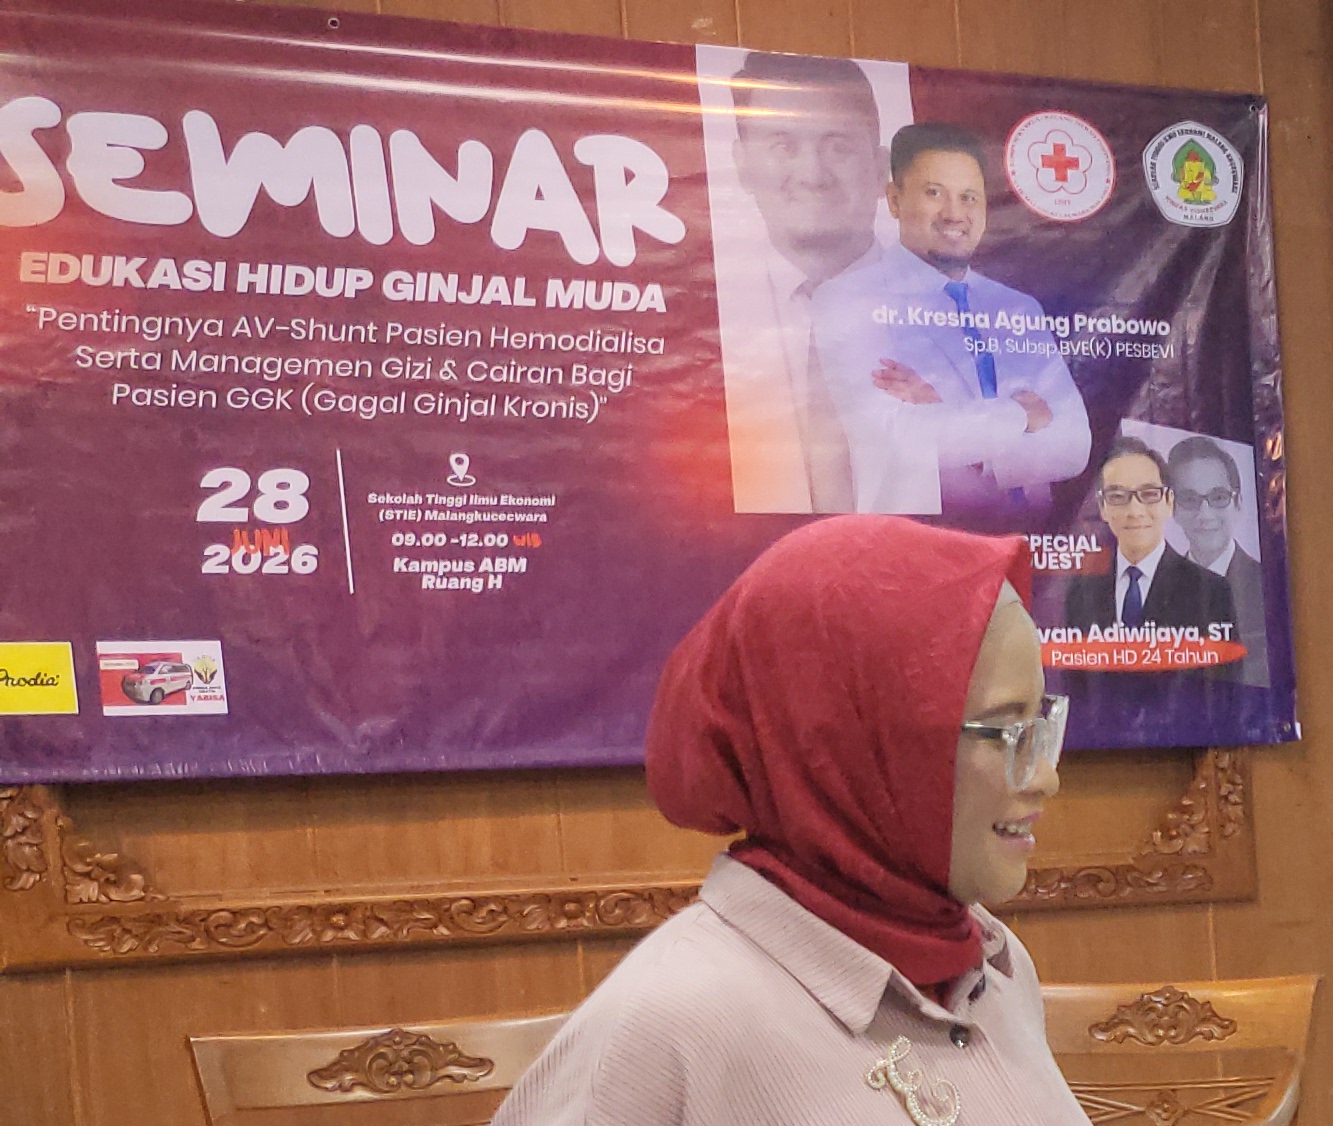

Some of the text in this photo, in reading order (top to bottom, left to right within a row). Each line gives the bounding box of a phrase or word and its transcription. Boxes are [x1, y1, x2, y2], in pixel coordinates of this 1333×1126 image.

[0, 96, 686, 266] SEMINAR
[20, 251, 667, 313] EDUKASI HIDUP GINJAL MUDA
[232, 316, 377, 344] AV-Shunt
[385, 322, 482, 348] Pasien
[490, 327, 665, 355] Hemodialisa
[872, 305, 1170, 338] dr. Kresna Agung Prabowo
[1116, 342, 1174, 359] PESBEVI
[76, 345, 633, 393] Serta Managemen Gizi & Cairan Bagi
[112, 383, 217, 408] Pasien
[226, 387, 293, 411] GGK
[302, 382, 405, 420] (Gagal
[414, 391, 496, 422] Ginjal
[196, 467, 310, 524] 28
[368, 492, 556, 507] Sekolah Tinggi Ilmu Ekonomi
[379, 509, 422, 522] (STIE)
[231, 527, 290, 556] JUNI
[392, 533, 446, 547] 09.00
[202, 544, 318, 575] 2026
[393, 556, 527, 576] Kampus ABM
[1031, 551, 1085, 570] UEST
[422, 574, 503, 593] Ruang H
[1087, 621, 1205, 648] Adiwijaya,
[1208, 623, 1233, 642] ST
[1052, 648, 1218, 666] Pasien HD 24 Tahun
